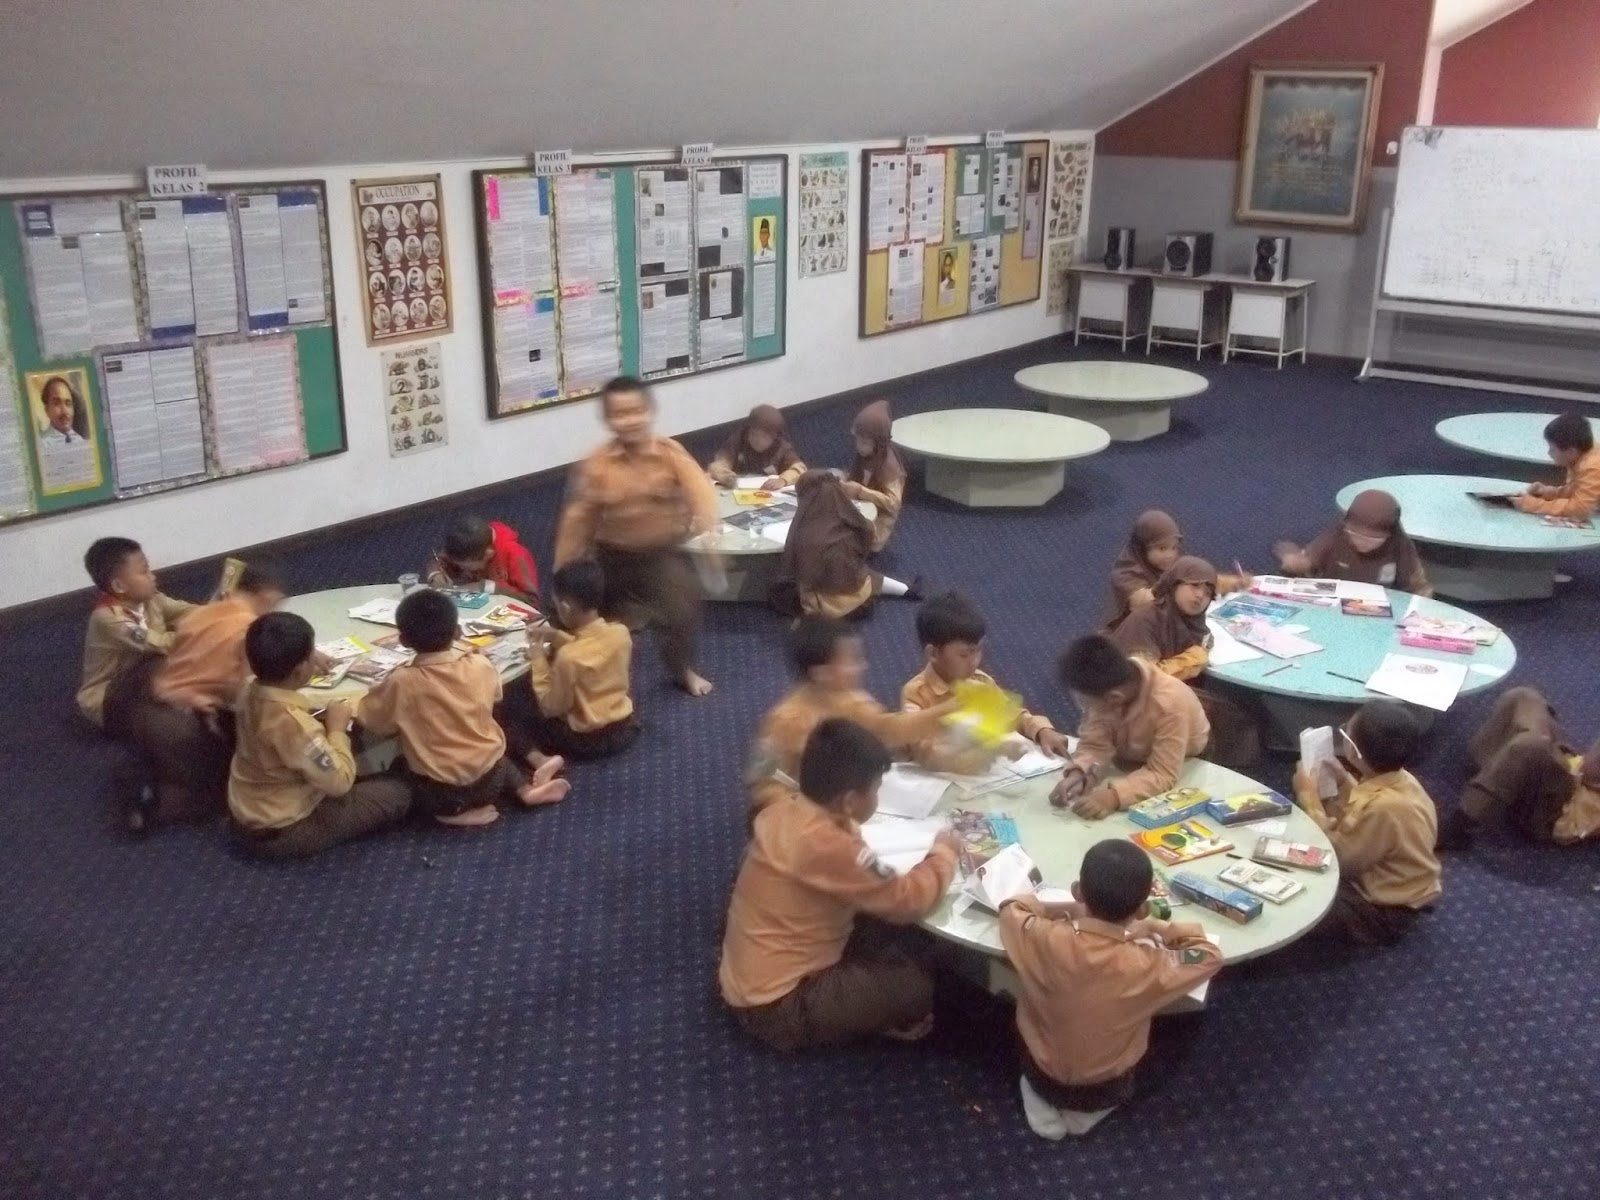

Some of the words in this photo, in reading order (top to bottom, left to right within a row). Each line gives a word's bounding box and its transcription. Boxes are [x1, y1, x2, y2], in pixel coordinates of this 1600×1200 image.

[539, 152, 566, 162] PROFIL
[154, 167, 197, 178] PROFIL
[537, 164, 563, 174] KELAS
[152, 182, 194, 194] KELAS
[199, 181, 205, 192] 2
[375, 185, 420, 198] OCCUPATION
[395, 347, 428, 359] NUMBERS
